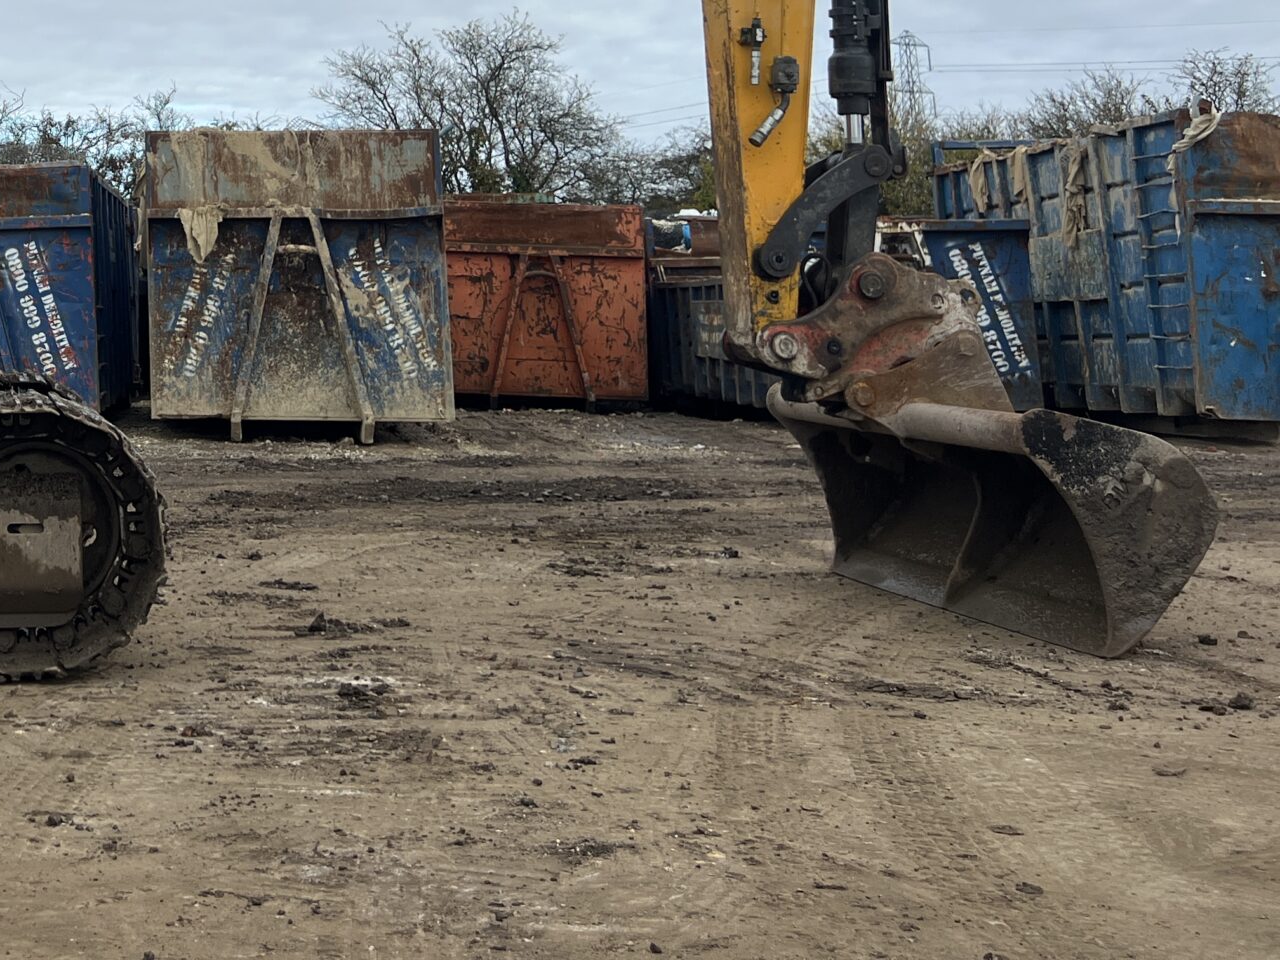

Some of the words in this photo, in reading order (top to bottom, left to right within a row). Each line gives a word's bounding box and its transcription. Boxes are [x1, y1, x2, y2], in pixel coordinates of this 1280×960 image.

[968, 241, 998, 293] PUTNAM
[3, 246, 29, 292] 0800
[19, 294, 41, 329] 999
[31, 331, 57, 376] 8700
[983, 329, 1009, 372] 8700
